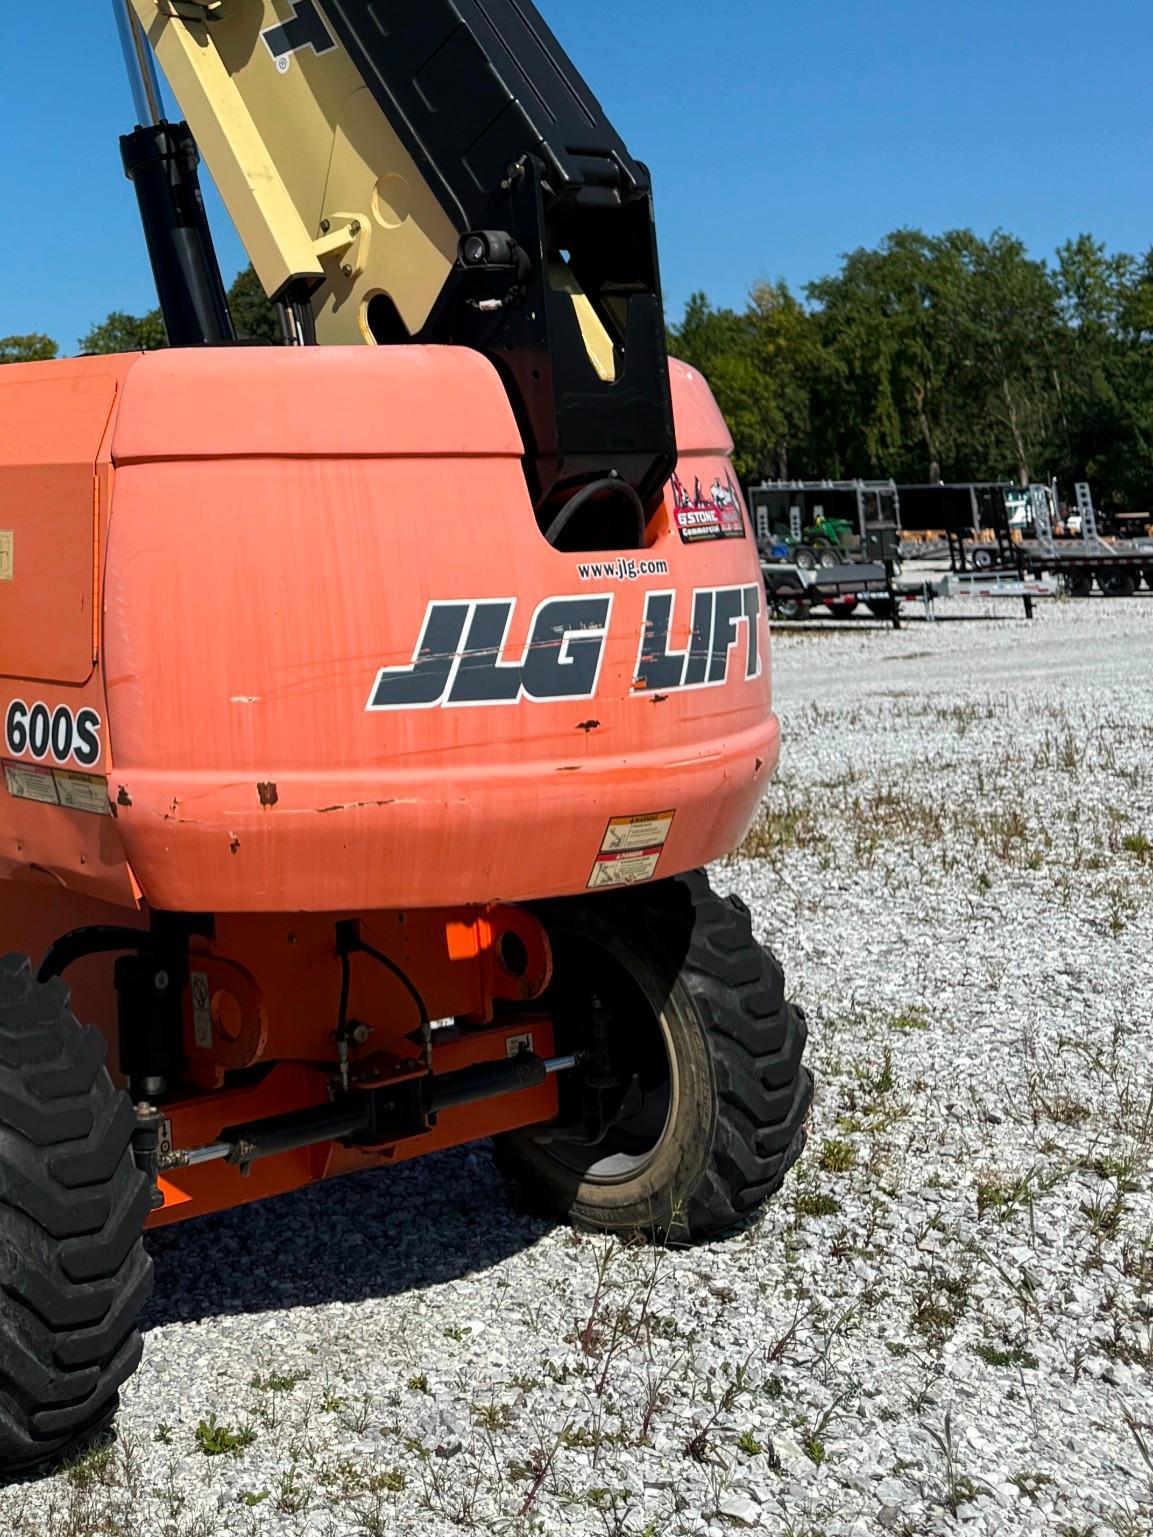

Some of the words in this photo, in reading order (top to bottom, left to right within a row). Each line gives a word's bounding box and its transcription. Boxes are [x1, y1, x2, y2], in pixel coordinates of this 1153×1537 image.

[577, 559, 668, 580] www.jlg.com
[368, 594, 612, 709] JLG
[630, 584, 760, 695] LIFT
[6, 700, 100, 765] 600S
